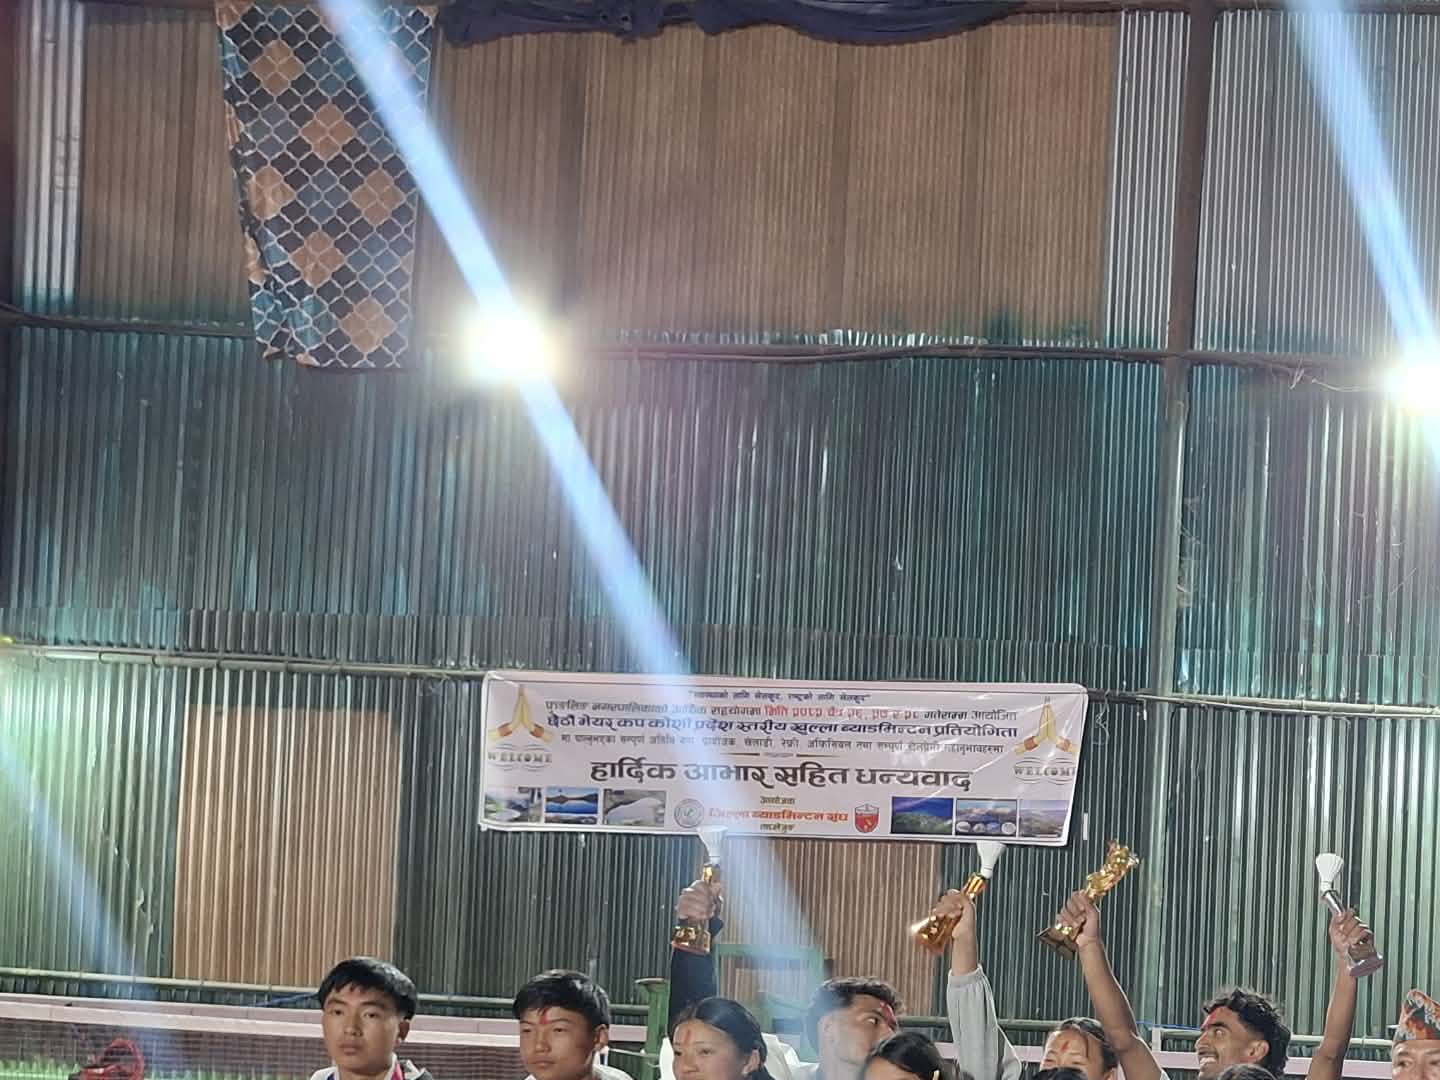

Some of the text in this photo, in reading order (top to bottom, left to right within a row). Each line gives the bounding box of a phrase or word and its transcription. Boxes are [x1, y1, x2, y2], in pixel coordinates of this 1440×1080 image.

[577, 714, 617, 731] मेयर
[617, 717, 645, 728] कप
[736, 719, 786, 734] स्तरीय
[790, 721, 836, 735] खुल्ला
[933, 723, 1018, 738] प्रतियोगिता
[488, 751, 553, 764] WELCOME
[590, 757, 976, 792] हार्दिक आभार सहित धन्यवाद
